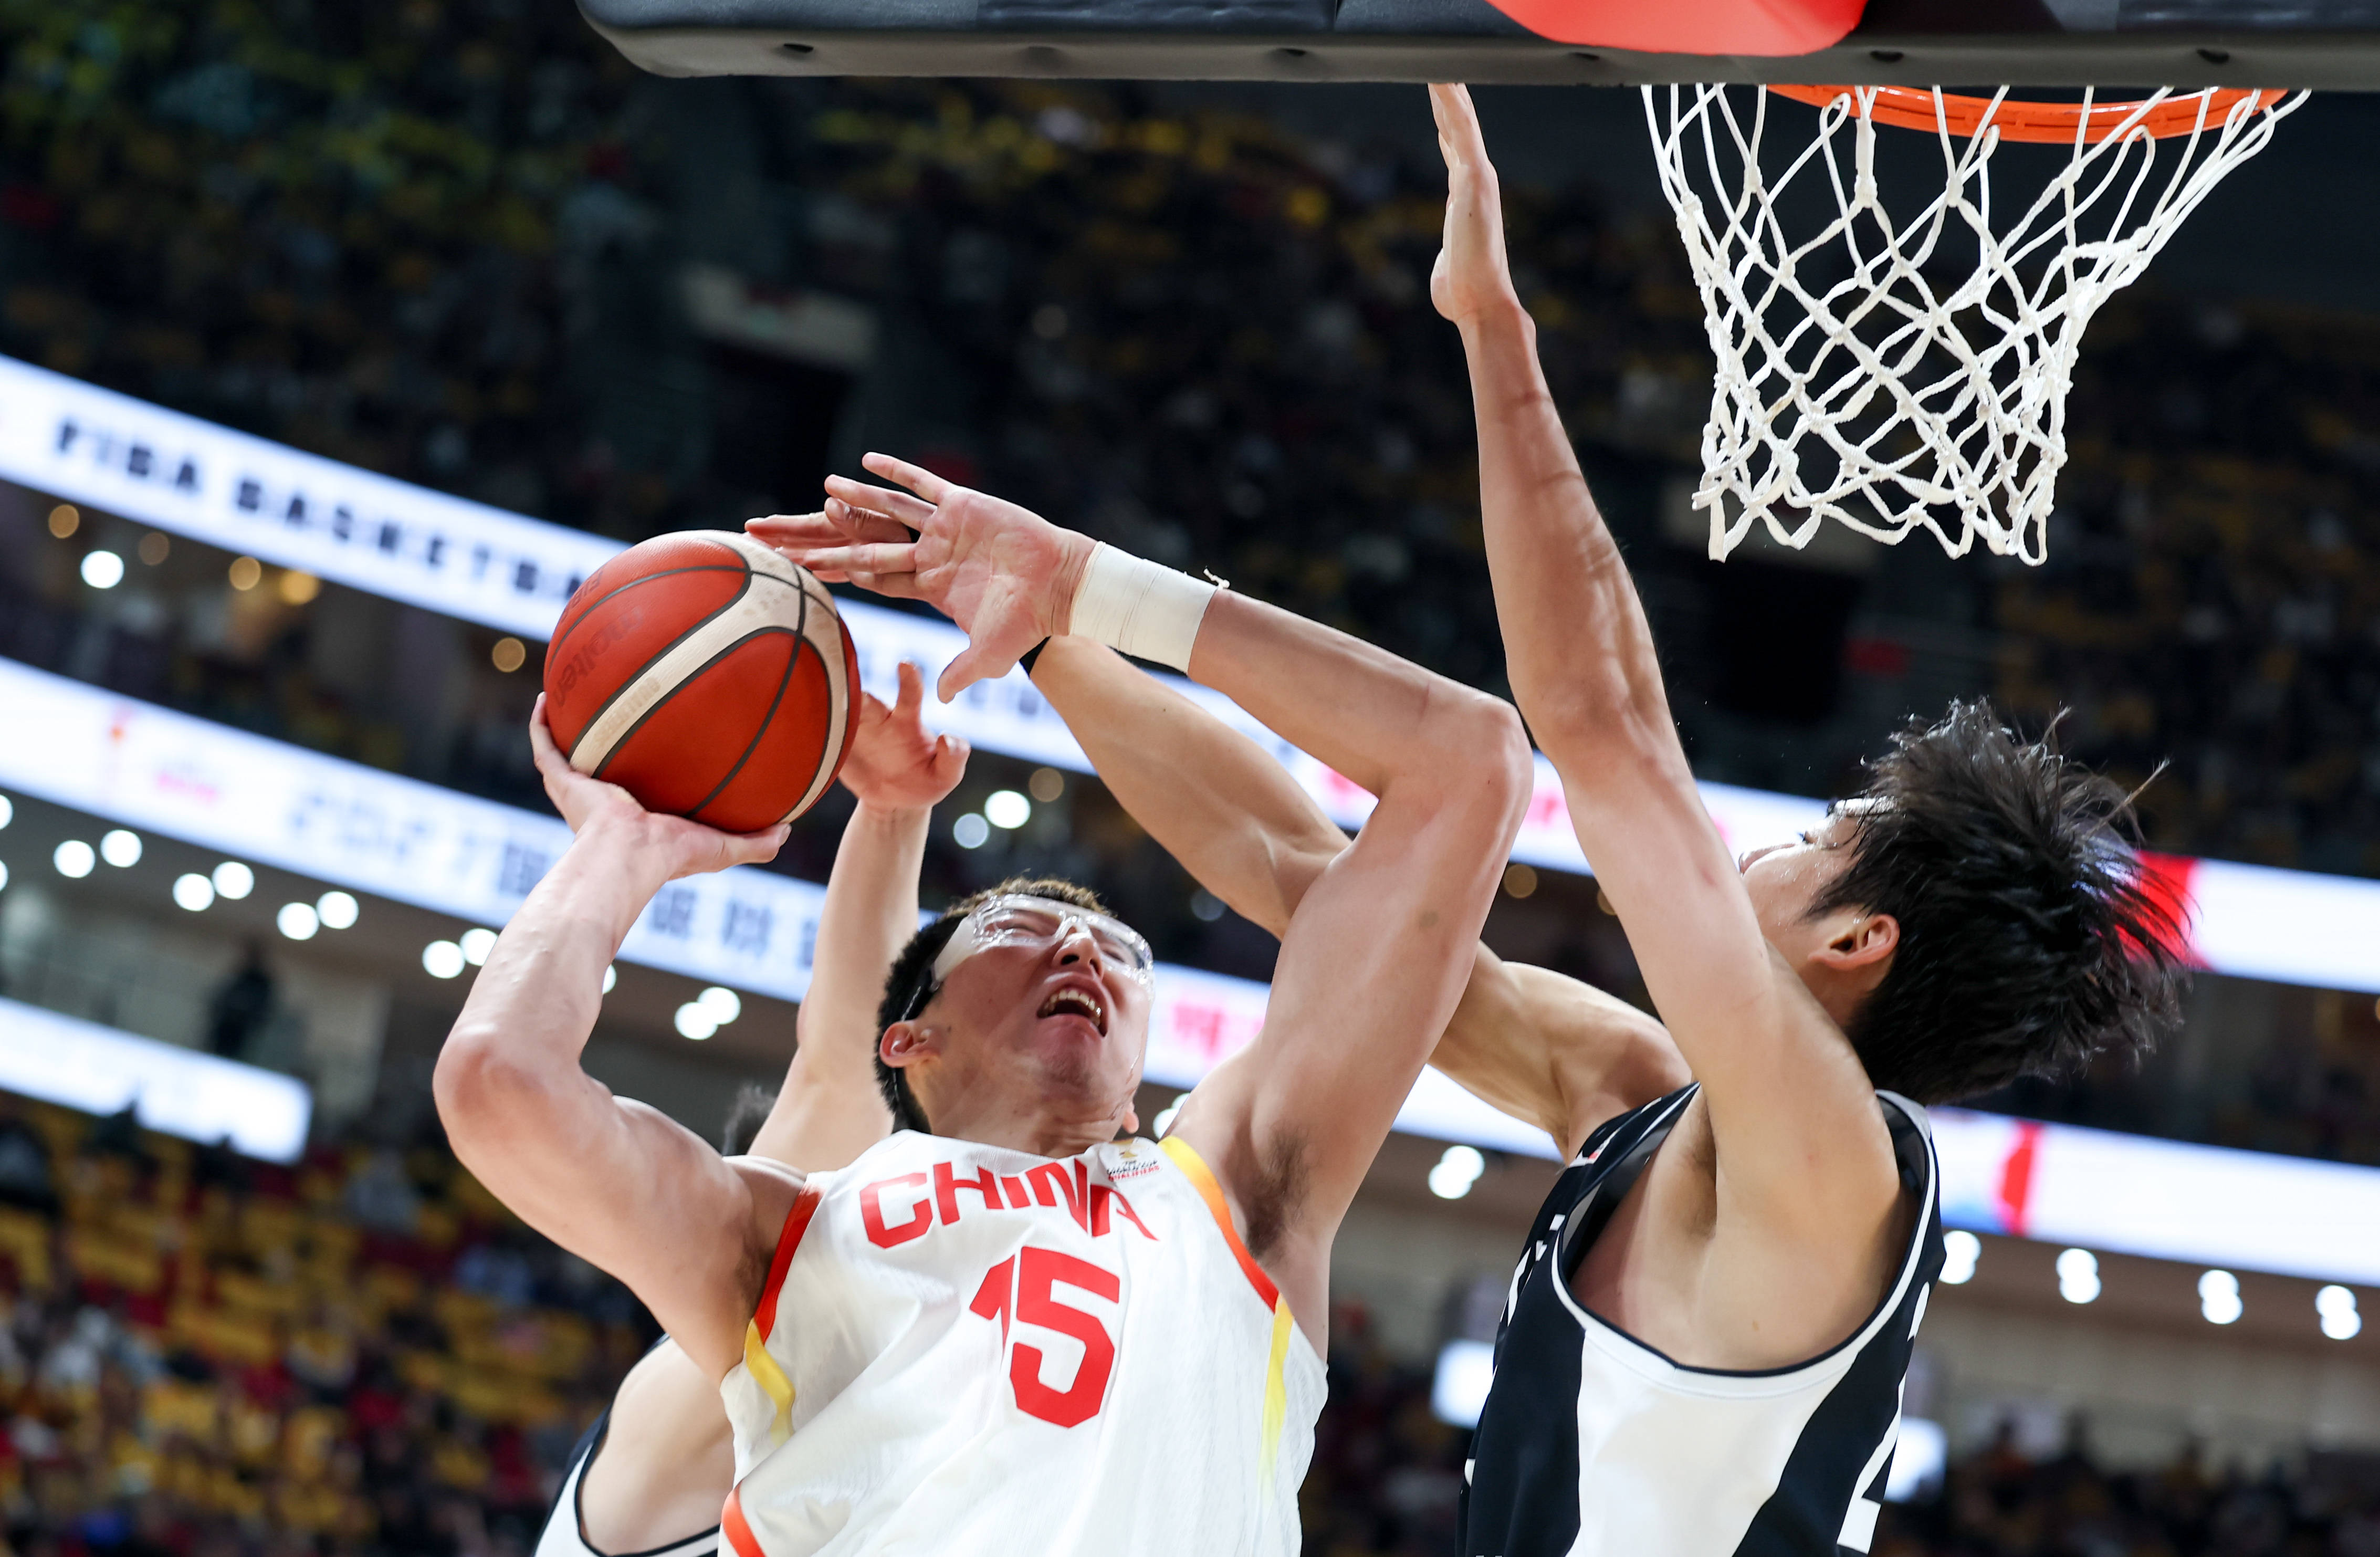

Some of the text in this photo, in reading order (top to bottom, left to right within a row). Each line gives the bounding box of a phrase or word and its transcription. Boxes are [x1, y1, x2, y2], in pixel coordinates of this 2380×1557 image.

[57, 418, 200, 489] FIBA
[859, 1157, 1160, 1249] CHINA
[969, 1246, 1120, 1429] 15
